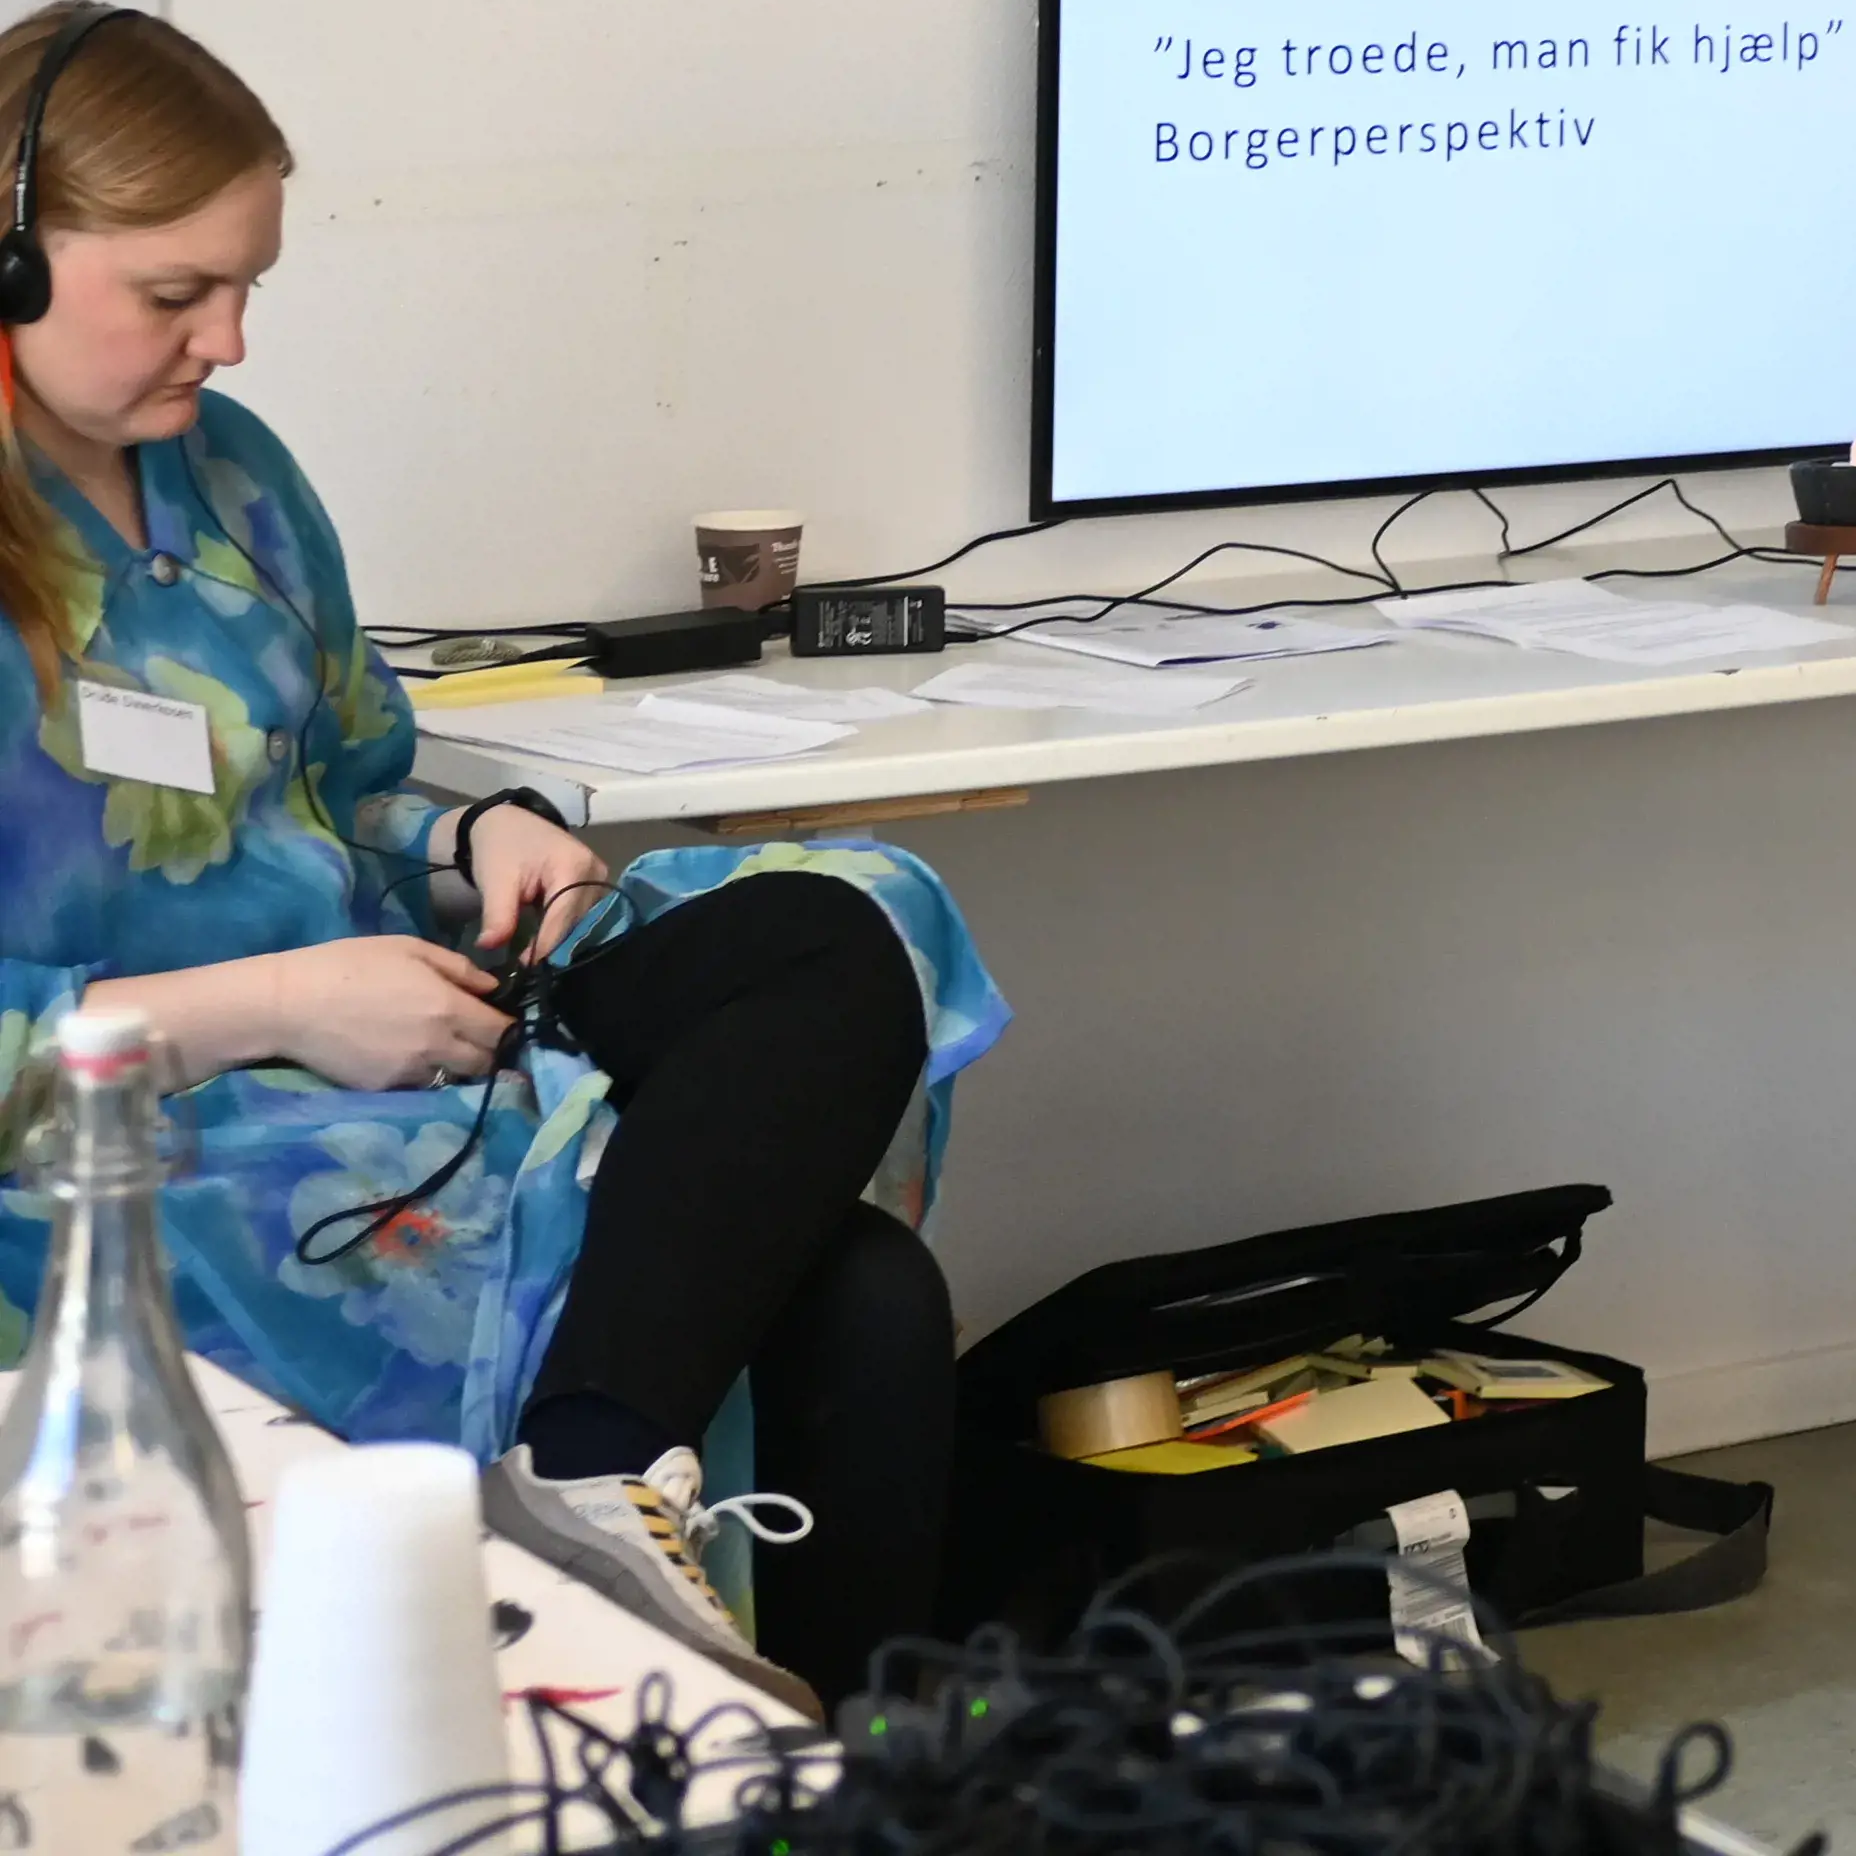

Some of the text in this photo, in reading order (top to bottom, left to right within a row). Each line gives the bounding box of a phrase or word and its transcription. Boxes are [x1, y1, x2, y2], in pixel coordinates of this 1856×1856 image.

[1281, 30, 1467, 81] troede,
[1491, 37, 1590, 71] man
[1613, 23, 1671, 68] fik
[1154, 107, 1596, 170] Borgerperspektiv
